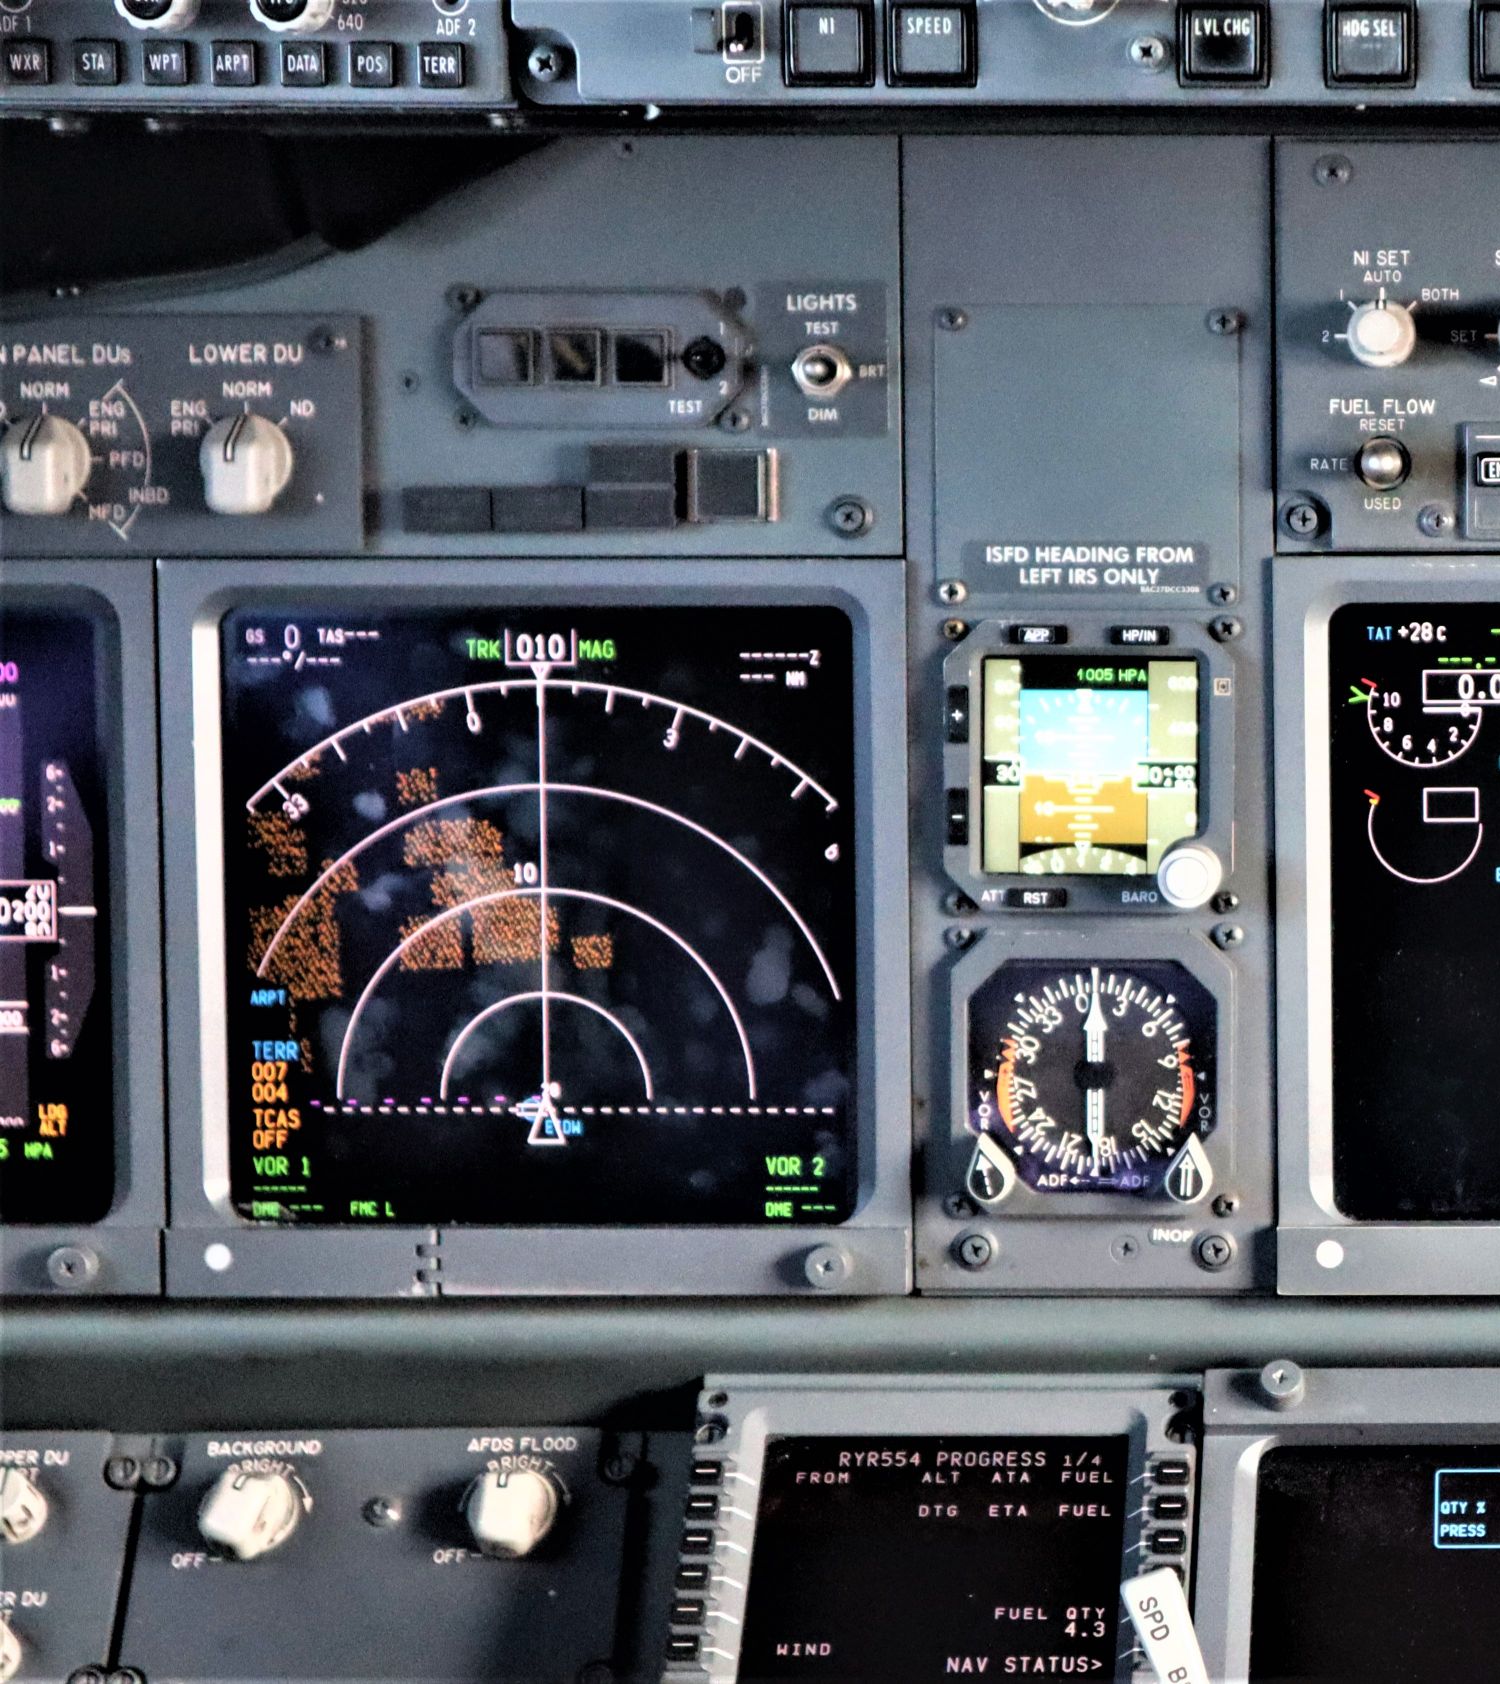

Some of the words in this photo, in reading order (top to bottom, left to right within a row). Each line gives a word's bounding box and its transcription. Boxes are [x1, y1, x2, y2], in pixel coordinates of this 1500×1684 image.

[907, 17, 952, 35] SPEED
[1194, 19, 1222, 36] LVL
[1223, 19, 1251, 36] CHG
[82, 54, 105, 71] STA
[150, 54, 178, 71] WPT
[215, 54, 249, 71] ARPT
[287, 55, 318, 72] DATA
[357, 56, 383, 73] POS
[423, 56, 456, 74] TERR
[725, 66, 762, 84] OFF
[1363, 270, 1402, 282] AUTO
[1421, 288, 1459, 300] BOTH
[786, 294, 857, 312] LIGHTS
[805, 321, 839, 335] TEST
[188, 344, 267, 364] LOWER
[273, 344, 302, 363] DU
[858, 363, 885, 378] BRT
[20, 381, 70, 398] NORM
[222, 381, 272, 398] NORM
[669, 400, 702, 414] TEST
[808, 407, 837, 422] DIM
[1329, 399, 1375, 415] FUEL
[1383, 399, 1436, 414] FLOW
[1359, 419, 1405, 432] RESET
[986, 546, 1030, 563] ISFD
[1036, 546, 1129, 563] HEADING
[1136, 546, 1194, 563] FROM
[1019, 568, 1062, 585] LEFT
[1069, 568, 1098, 584] IRS
[1104, 568, 1160, 585] ONLY
[1367, 626, 1393, 641] TAT
[466, 639, 500, 658] TRK
[516, 633, 566, 660] 010
[578, 640, 615, 659] MAG
[1382, 692, 1401, 707] 10
[513, 862, 538, 884] 10
[1023, 891, 1048, 904] RST
[1122, 891, 1158, 903] BARO
[250, 989, 286, 1006] ARPT
[252, 1040, 299, 1061] TERR
[252, 1062, 288, 1082] 007
[252, 1082, 288, 1102] 004
[253, 1108, 301, 1130] TCAS
[765, 1156, 800, 1176] VOR
[813, 1157, 824, 1176] 2
[1037, 1174, 1067, 1187] ADF
[1119, 1174, 1149, 1187] ADF
[765, 1201, 792, 1218] DME
[1152, 1228, 1194, 1242] INOP
[207, 1440, 321, 1457] BACKGROUND
[467, 1437, 514, 1452] AFDS
[520, 1436, 578, 1451] FLOOD
[839, 1451, 921, 1468] RYR554
[936, 1451, 1046, 1468] PROGRESS
[1063, 1453, 1102, 1468] 1/4
[796, 1472, 850, 1484] FROM
[922, 1472, 960, 1484] ALT
[991, 1472, 1031, 1484] ATA
[1061, 1471, 1114, 1484] FUEL
[918, 1505, 958, 1517] DTG
[988, 1504, 1028, 1517] ETA
[1058, 1504, 1111, 1517] FUEL
[1440, 1501, 1468, 1515] QTY
[1440, 1524, 1486, 1538] PRESS
[171, 1553, 206, 1569] OFF
[433, 1549, 467, 1564] OFF
[995, 1607, 1048, 1620] FUEL
[1066, 1607, 1106, 1620] QTY
[1138, 1596, 1170, 1641] SPD
[1064, 1621, 1106, 1638] 4.3
[776, 1643, 832, 1656] WIND
